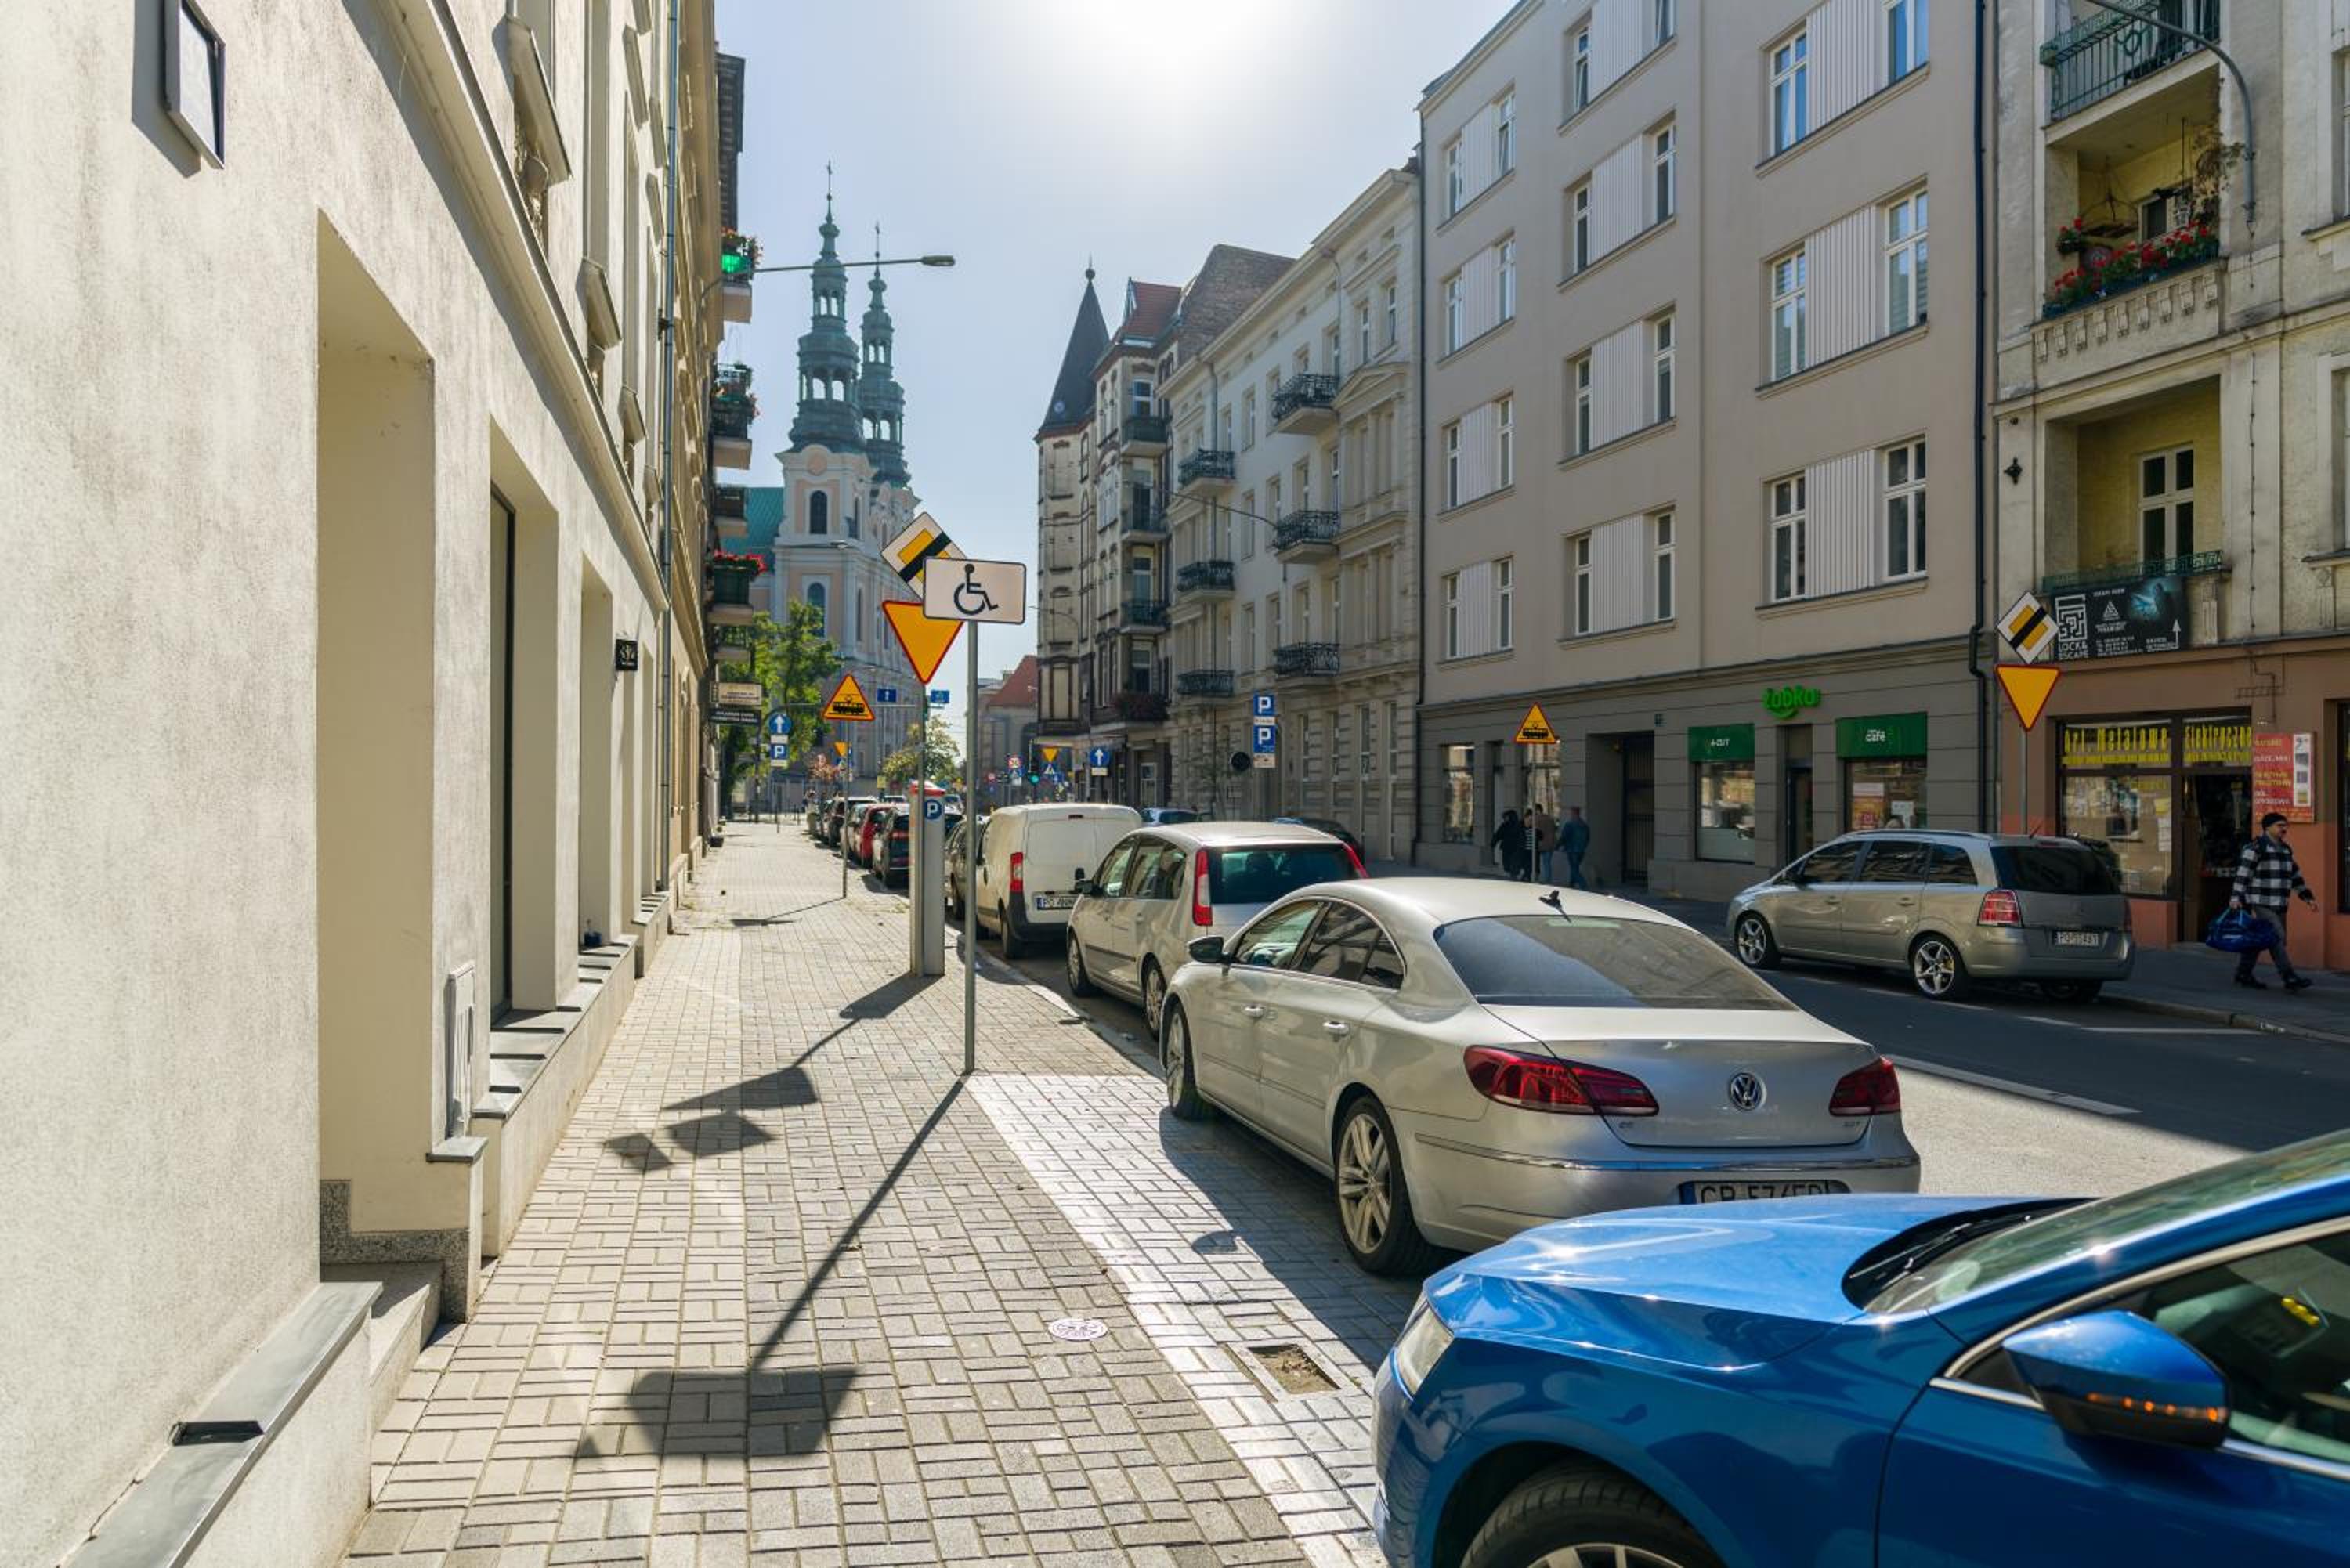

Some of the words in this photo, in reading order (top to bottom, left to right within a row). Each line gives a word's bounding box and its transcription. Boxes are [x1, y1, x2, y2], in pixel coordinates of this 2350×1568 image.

[2058, 641, 2088, 651] LOCK&
[2058, 650, 2088, 660] ESCAPE
[1257, 696, 1271, 714] P
[1257, 728, 1271, 745] P
[2097, 726, 2167, 752] Metalowe
[774, 746, 784, 758] P
[927, 804, 938, 815] P
